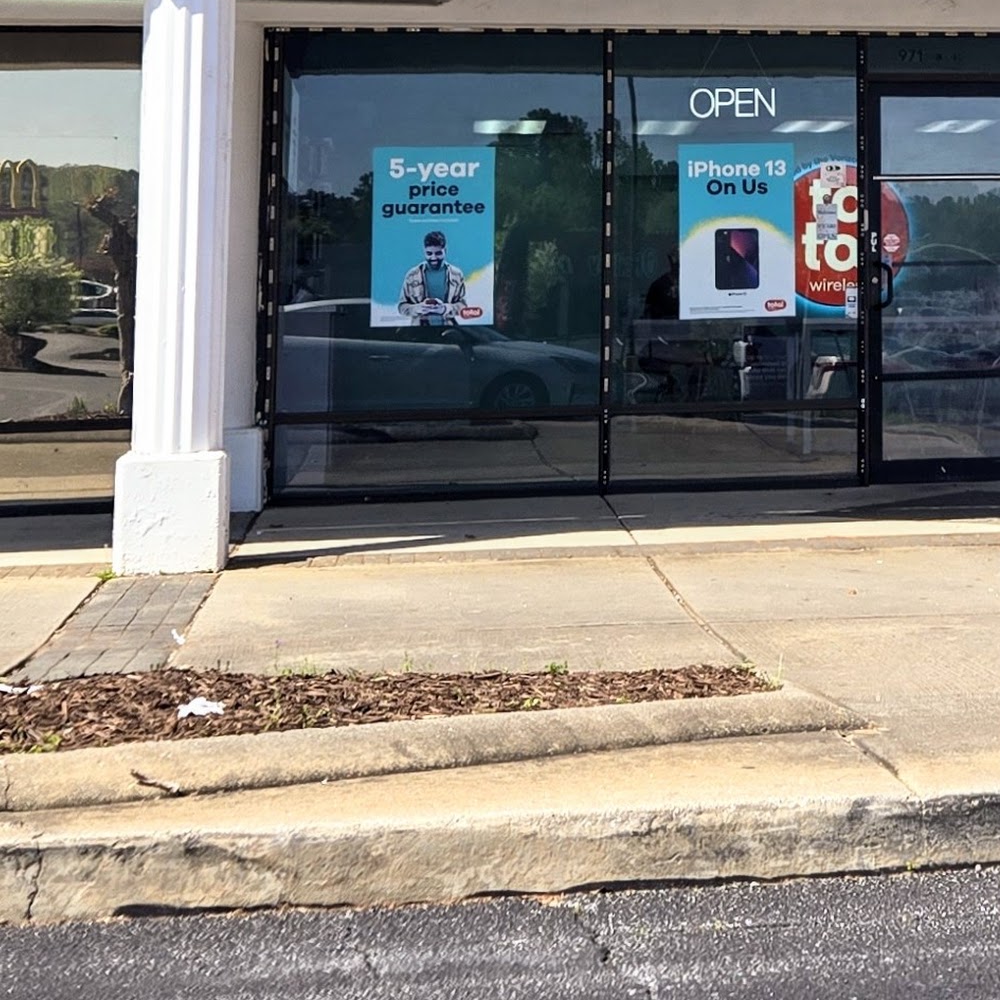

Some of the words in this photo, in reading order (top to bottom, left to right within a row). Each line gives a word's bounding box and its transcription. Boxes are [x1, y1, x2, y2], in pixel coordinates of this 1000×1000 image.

[689, 87, 776, 118] OPEN
[389, 158, 480, 182] 5-year
[688, 160, 760, 178] iPhone
[764, 160, 787, 176] 13
[409, 181, 459, 199] price
[706, 179, 736, 195] On
[742, 179, 768, 195] Us
[381, 200, 485, 218] guarantee
[802, 222, 858, 272] ta
[809, 278, 858, 292] wirel
